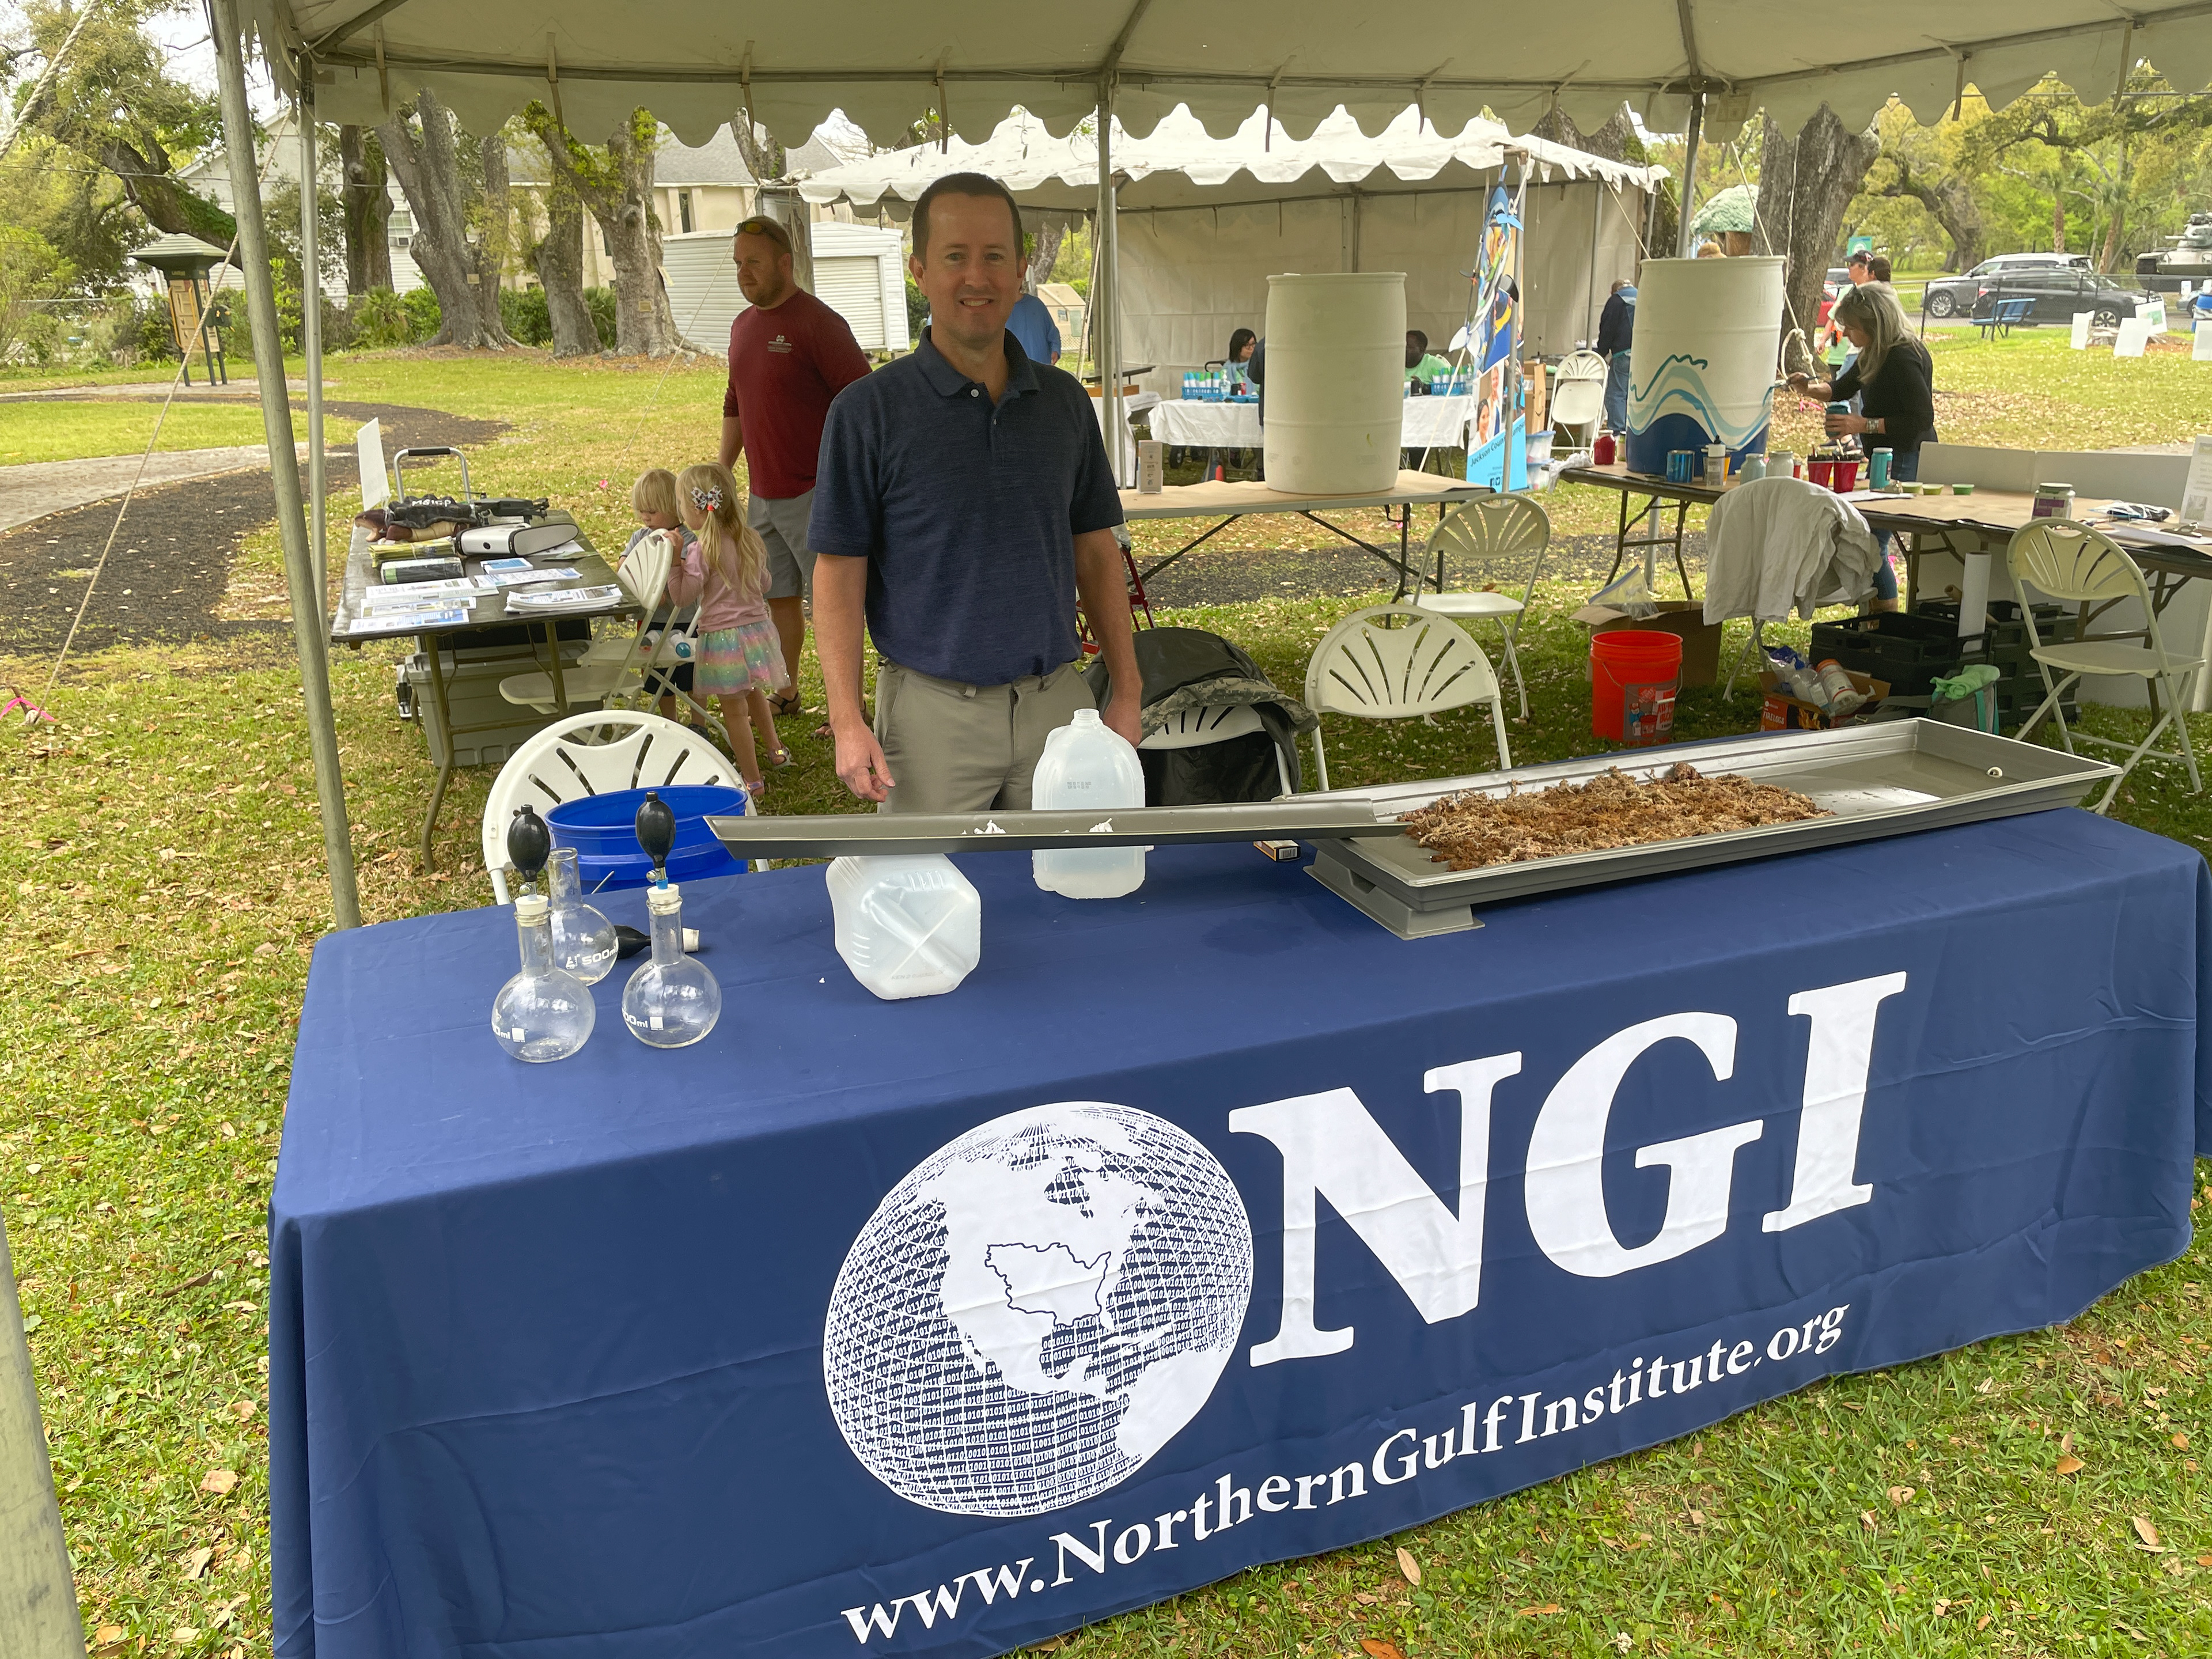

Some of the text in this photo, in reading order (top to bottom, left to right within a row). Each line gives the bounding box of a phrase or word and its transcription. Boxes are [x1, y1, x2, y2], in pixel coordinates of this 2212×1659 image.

[1763, 711, 1785, 725] FIRELOGS
[622, 1008, 648, 1028] 00ml
[1229, 971, 1906, 1367] NGI
[841, 1304, 1850, 1643] www.NorthernGulfInstitute.org
